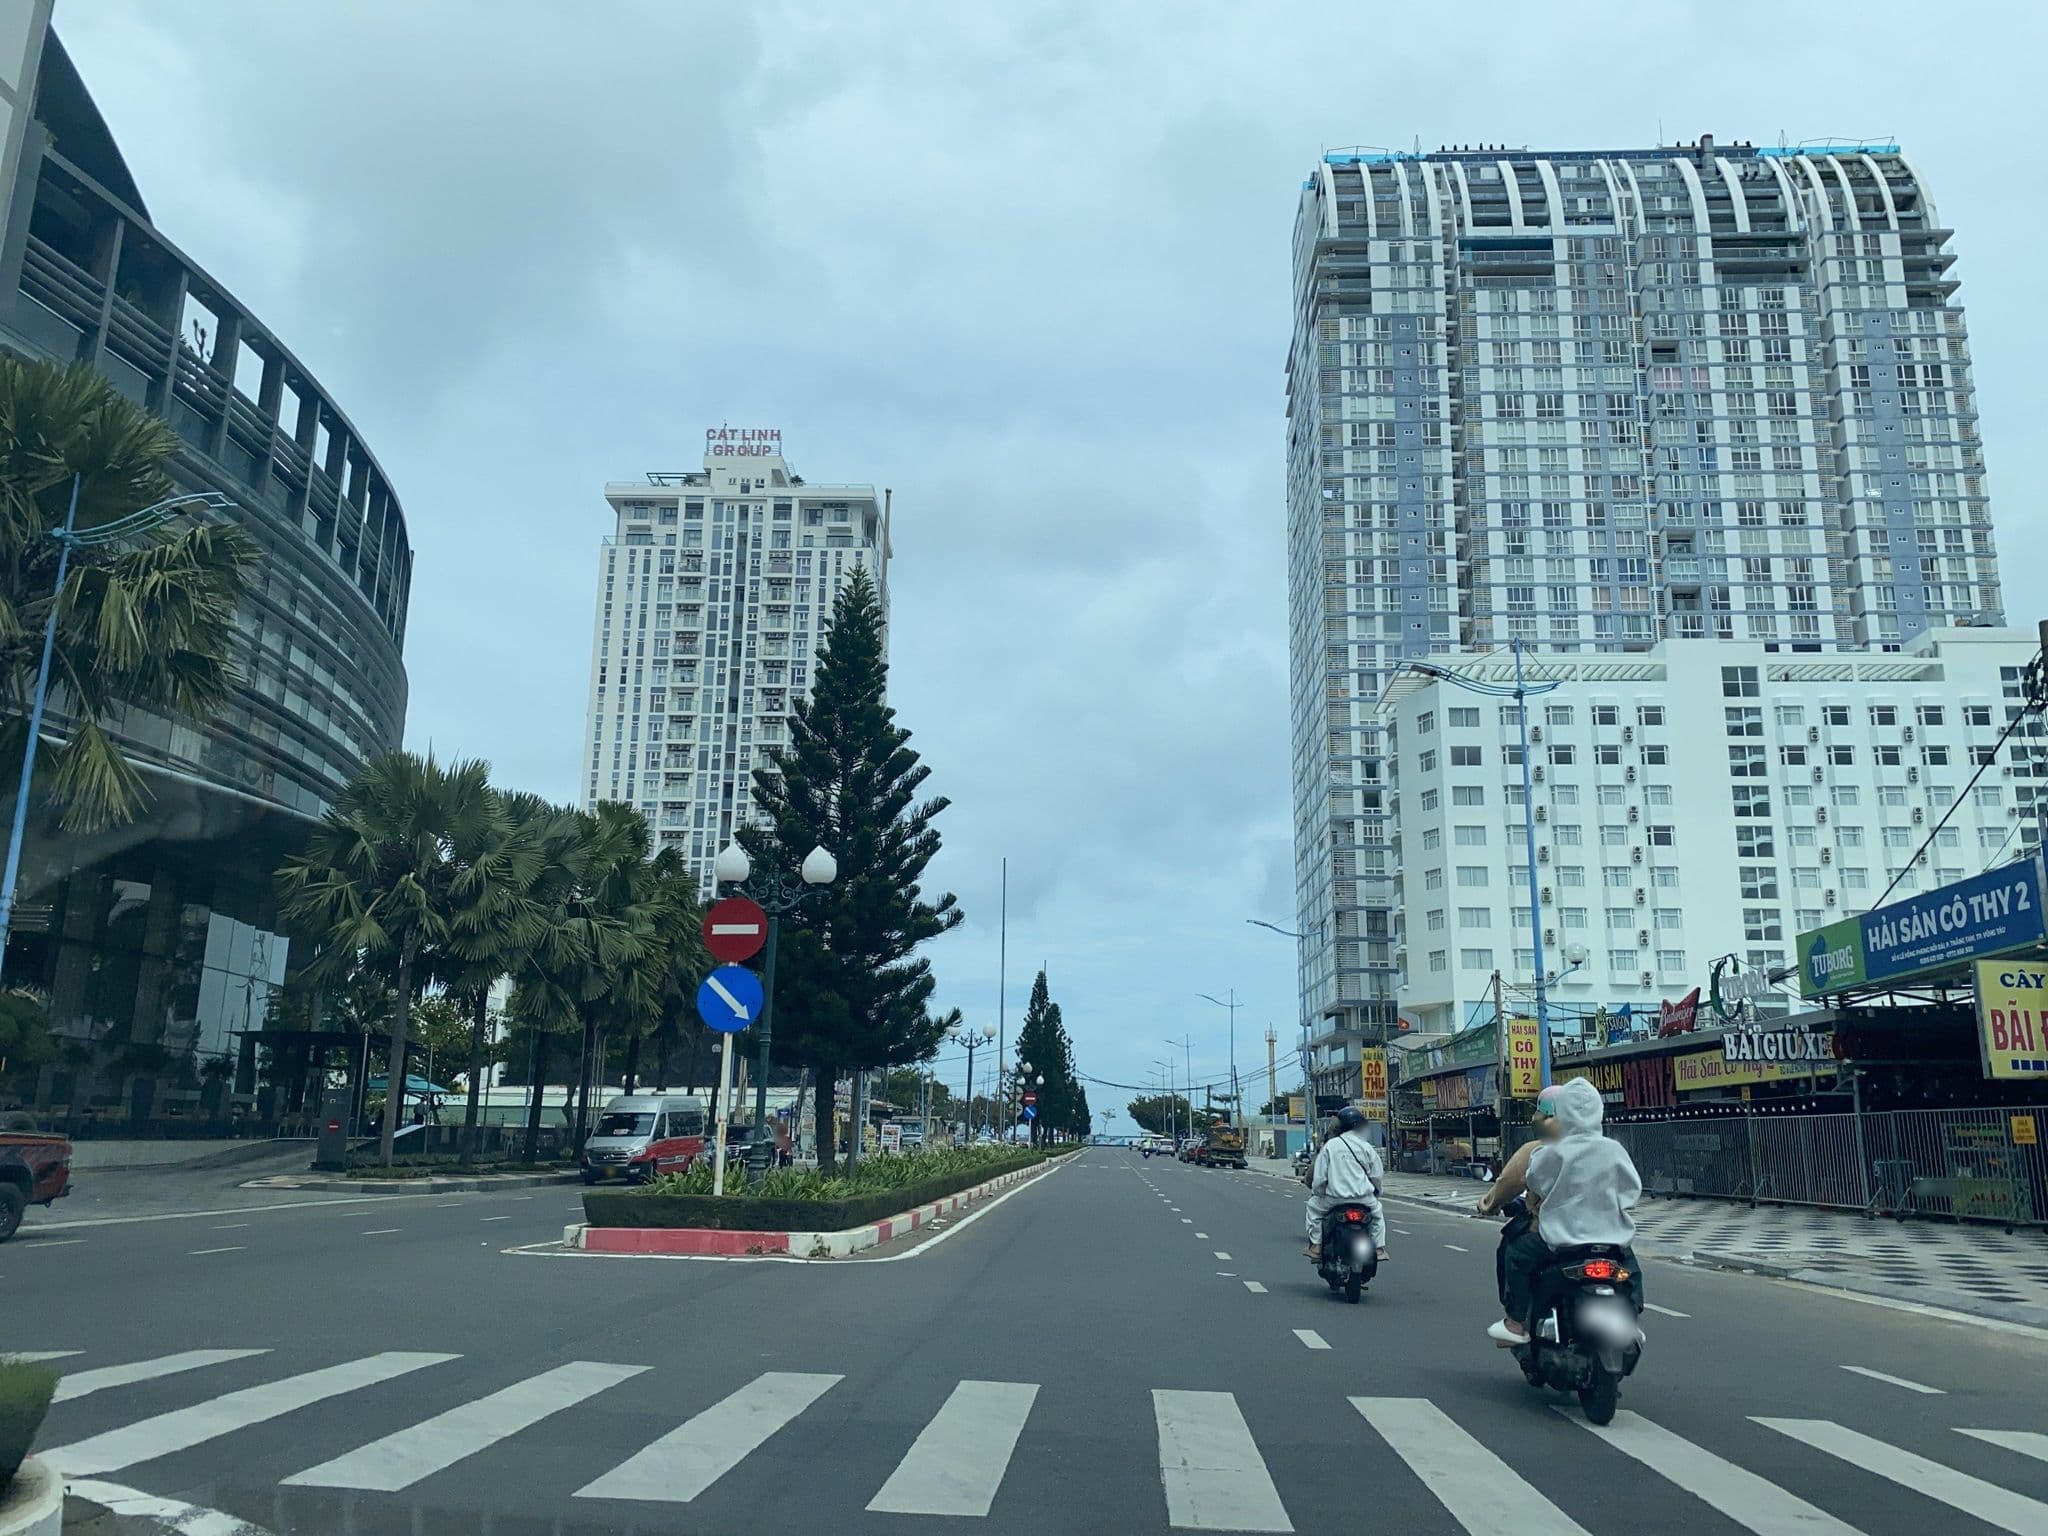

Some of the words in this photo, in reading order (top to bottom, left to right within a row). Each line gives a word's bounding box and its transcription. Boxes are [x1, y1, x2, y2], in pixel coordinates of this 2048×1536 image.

[742, 429, 781, 441] LINH
[713, 444, 772, 456] GROUP
[1867, 915, 1898, 953] HẢI
[1899, 905, 1937, 943] SẢN
[1940, 894, 1968, 932] CÔ
[1969, 885, 2012, 923] THY
[2014, 881, 2031, 911] 2
[1811, 945, 1854, 979] TUBORG
[1999, 969, 2046, 989] CÂY
[1511, 1022, 1523, 1035] HẢI
[1524, 1021, 1537, 1035] SẢN
[1990, 999, 2035, 1051] BÃI
[1515, 1039, 1533, 1053] CÔ
[1366, 1061, 1382, 1075] CÔ
[1513, 1057, 1537, 1069] THY
[1364, 1077, 1385, 1090] THU
[1522, 1073, 1531, 1085] 2
